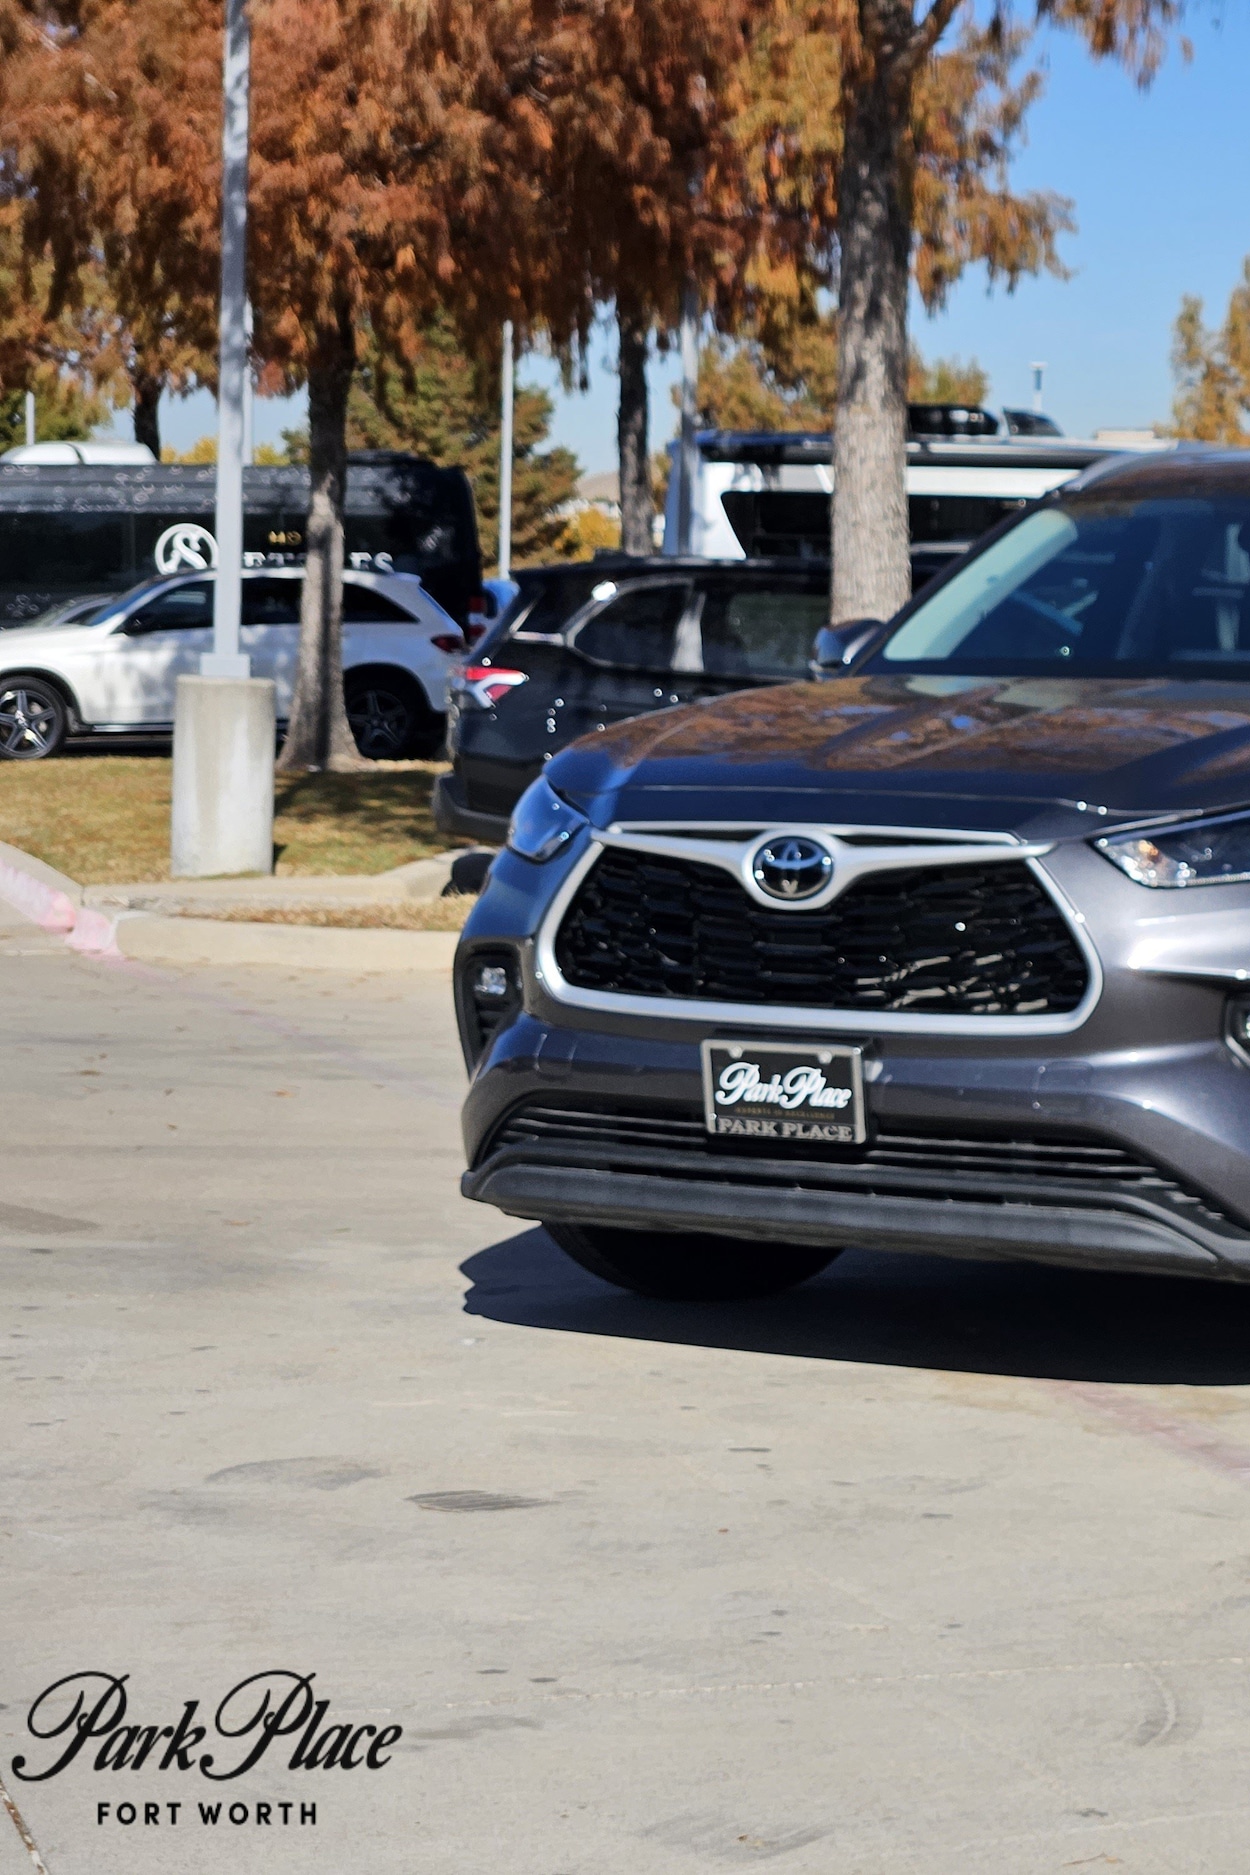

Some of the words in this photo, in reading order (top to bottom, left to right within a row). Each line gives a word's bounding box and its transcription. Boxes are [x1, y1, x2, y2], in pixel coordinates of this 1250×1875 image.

[715, 1061, 784, 1105] Park
[779, 1066, 852, 1109] Place
[717, 1117, 778, 1136] PARK
[781, 1122, 853, 1142] PLACE
